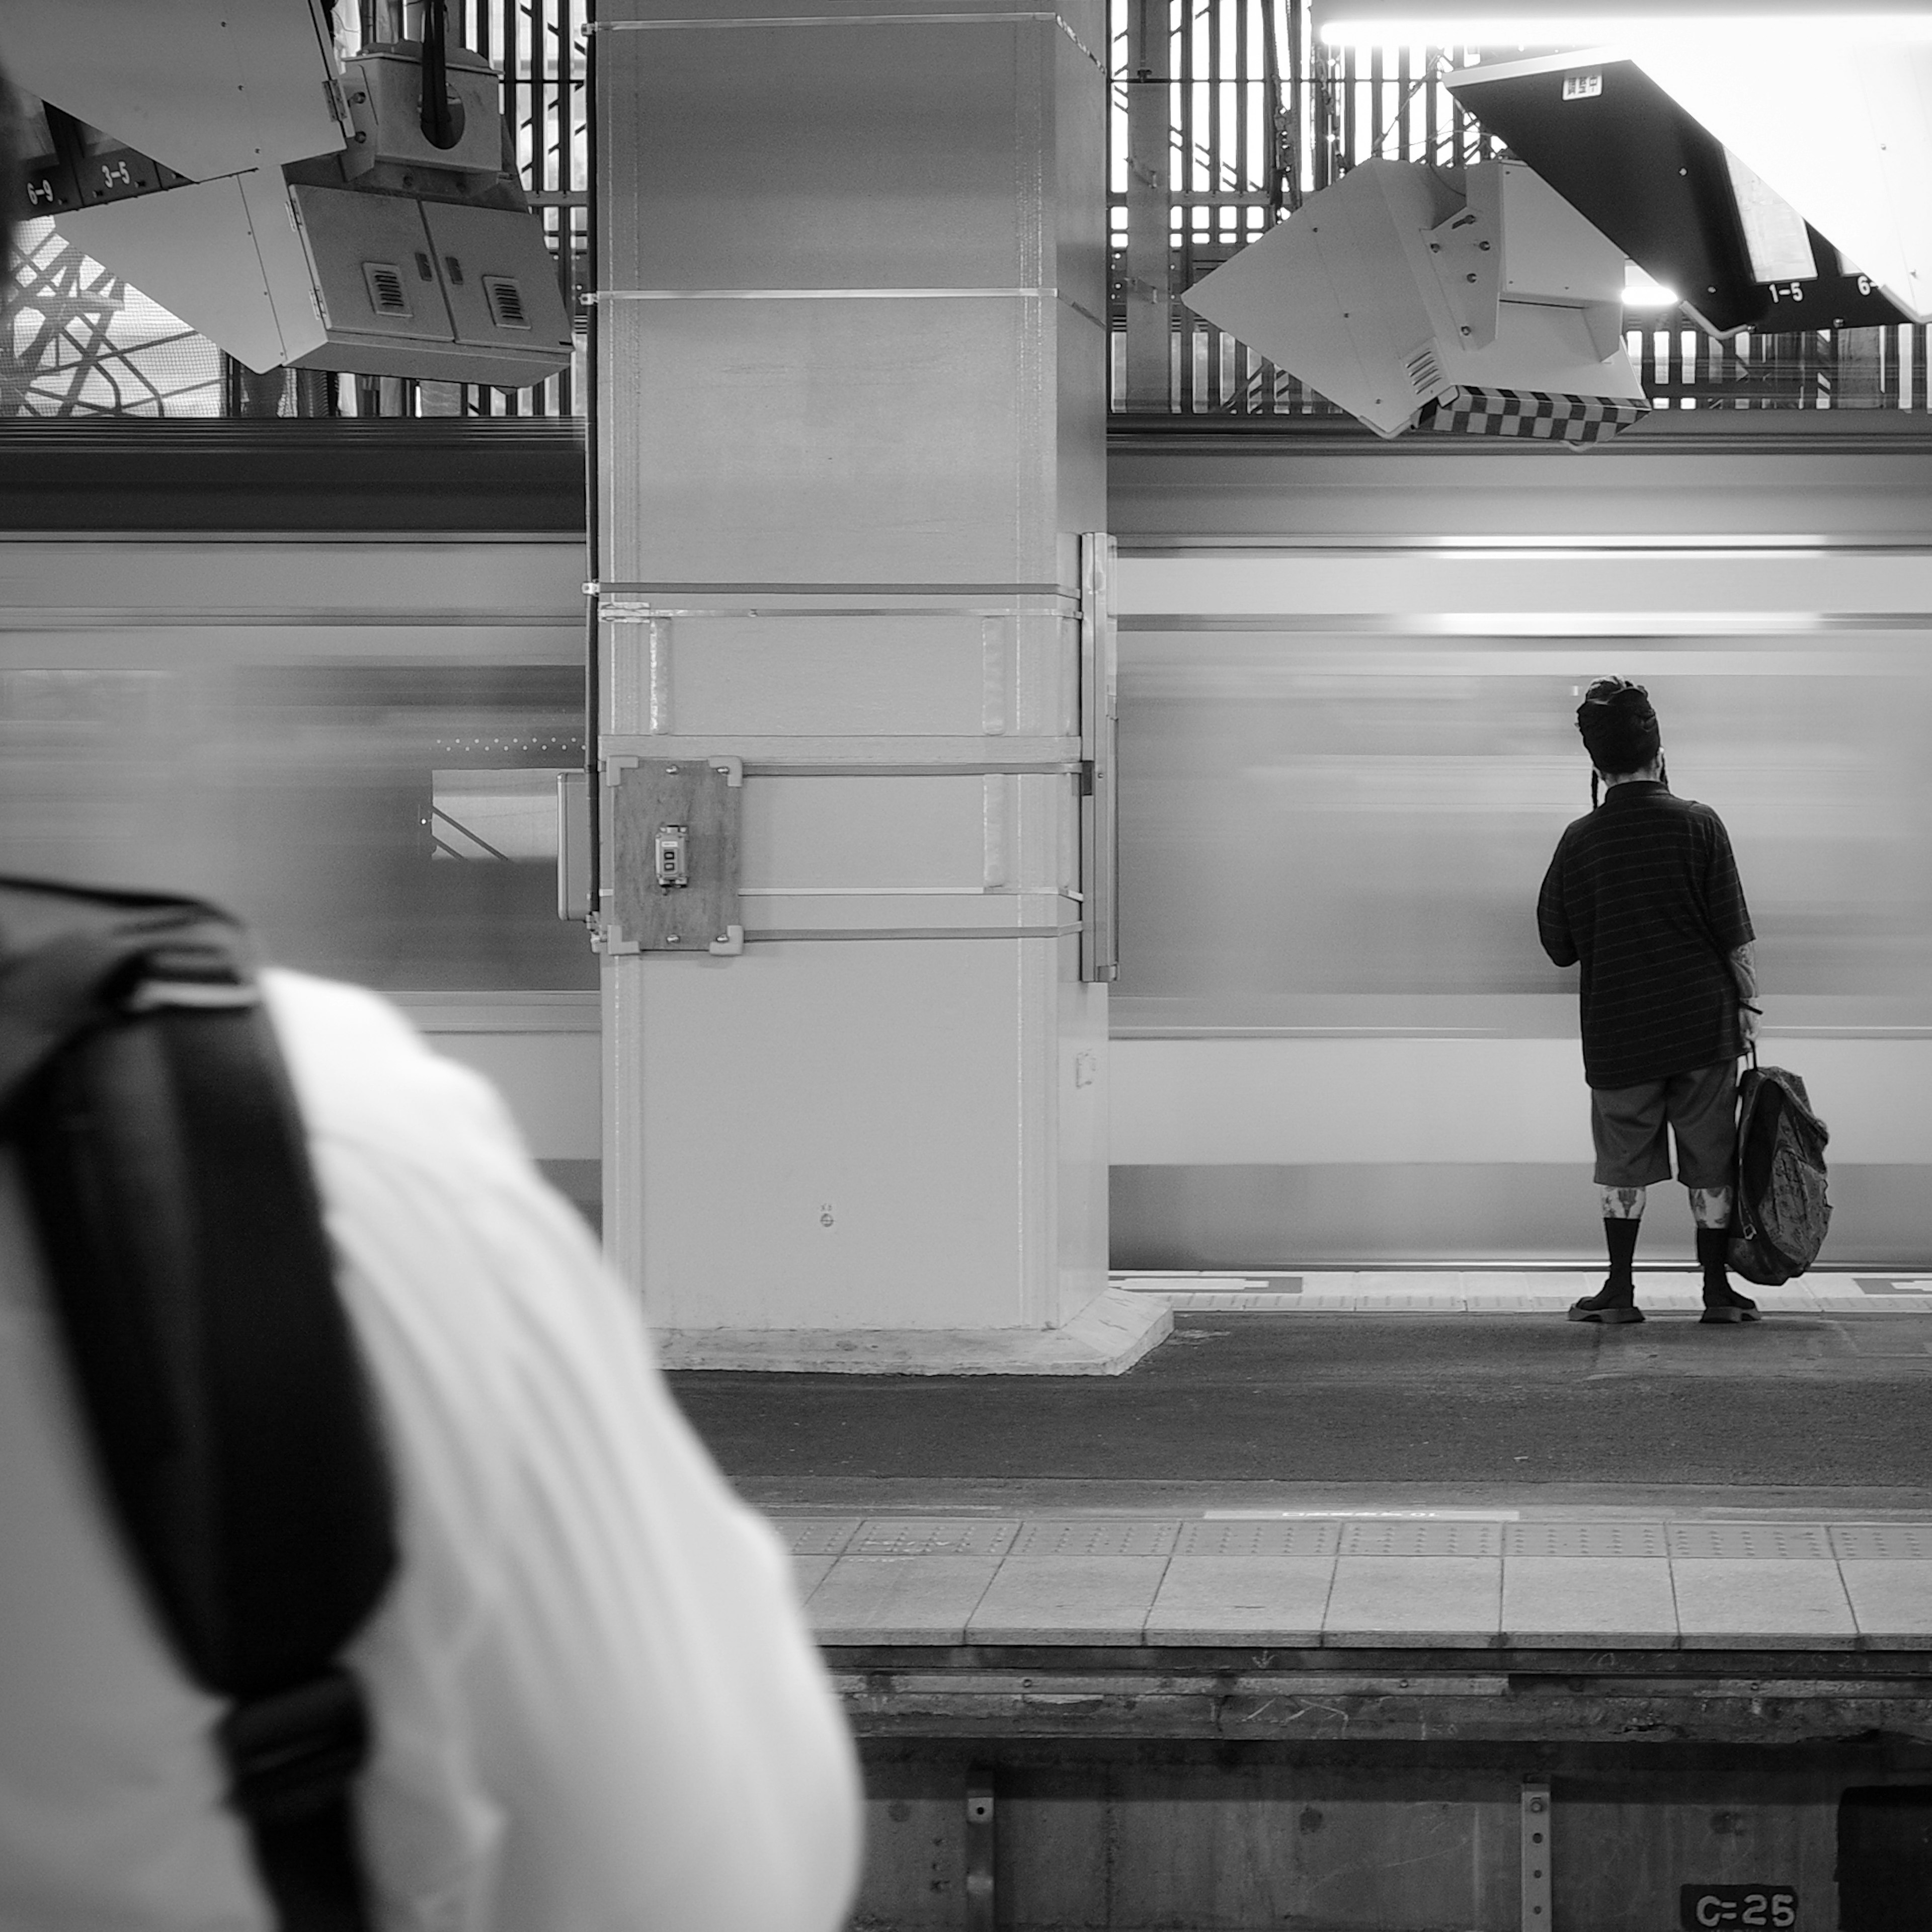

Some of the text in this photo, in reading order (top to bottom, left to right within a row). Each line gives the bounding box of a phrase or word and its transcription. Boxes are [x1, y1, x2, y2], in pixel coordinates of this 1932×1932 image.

[102, 161, 129, 188] 3-5
[27, 180, 53, 205] 6-9
[1769, 282, 1803, 303] 1-5
